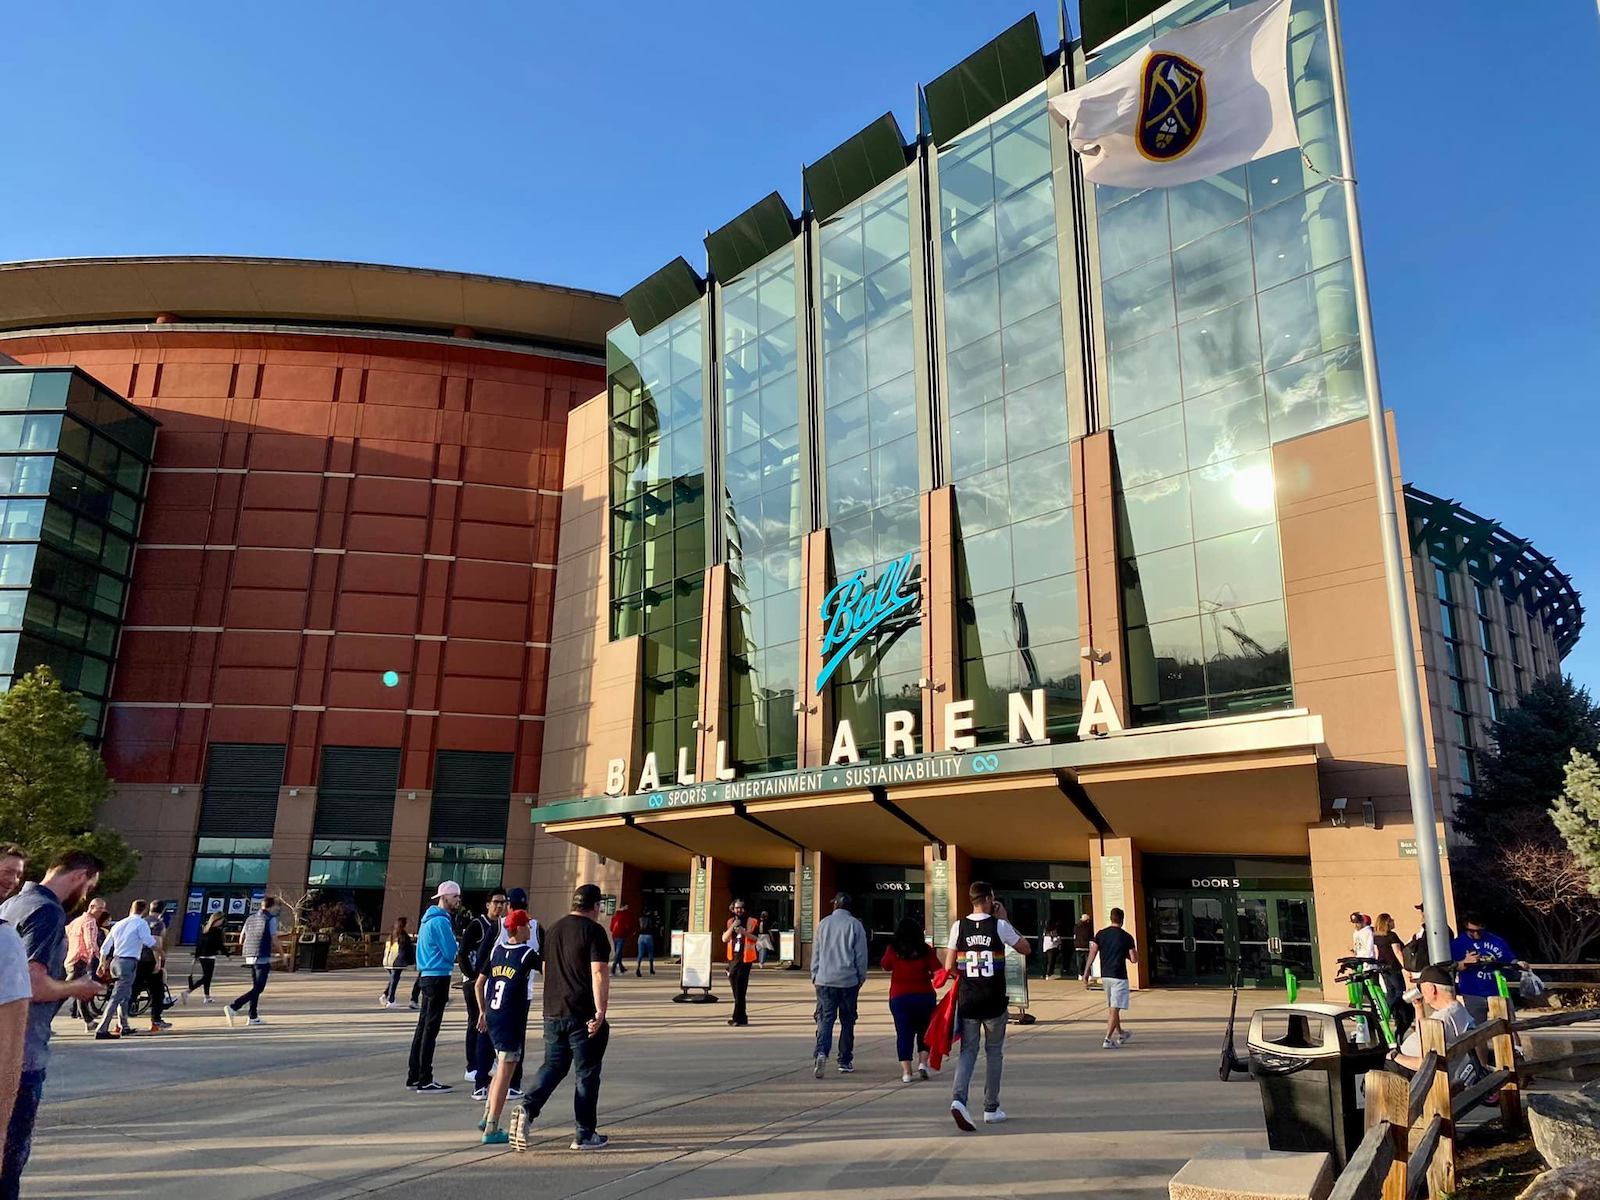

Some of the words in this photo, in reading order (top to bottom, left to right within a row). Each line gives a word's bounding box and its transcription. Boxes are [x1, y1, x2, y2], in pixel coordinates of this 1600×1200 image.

[816, 551, 918, 695] Ball
[605, 739, 736, 796] BALL
[828, 679, 1125, 767] ARENA
[668, 788, 707, 807] SPORTS
[724, 773, 823, 800] ENTERTAINMENT
[845, 757, 964, 787] SUSTAINABILITY
[875, 883, 902, 891] DOOR
[904, 883, 911, 891] 3
[1023, 882, 1055, 890] DOOR
[1057, 882, 1065, 890] 4
[1191, 879, 1230, 888] DOOR
[1232, 879, 1240, 888] 5
[965, 934, 993, 947] SNYDER
[1483, 941, 1504, 959] HIGH
[966, 950, 994, 978] 23
[1476, 971, 1493, 980] CIT
[490, 980, 506, 1010] 3
